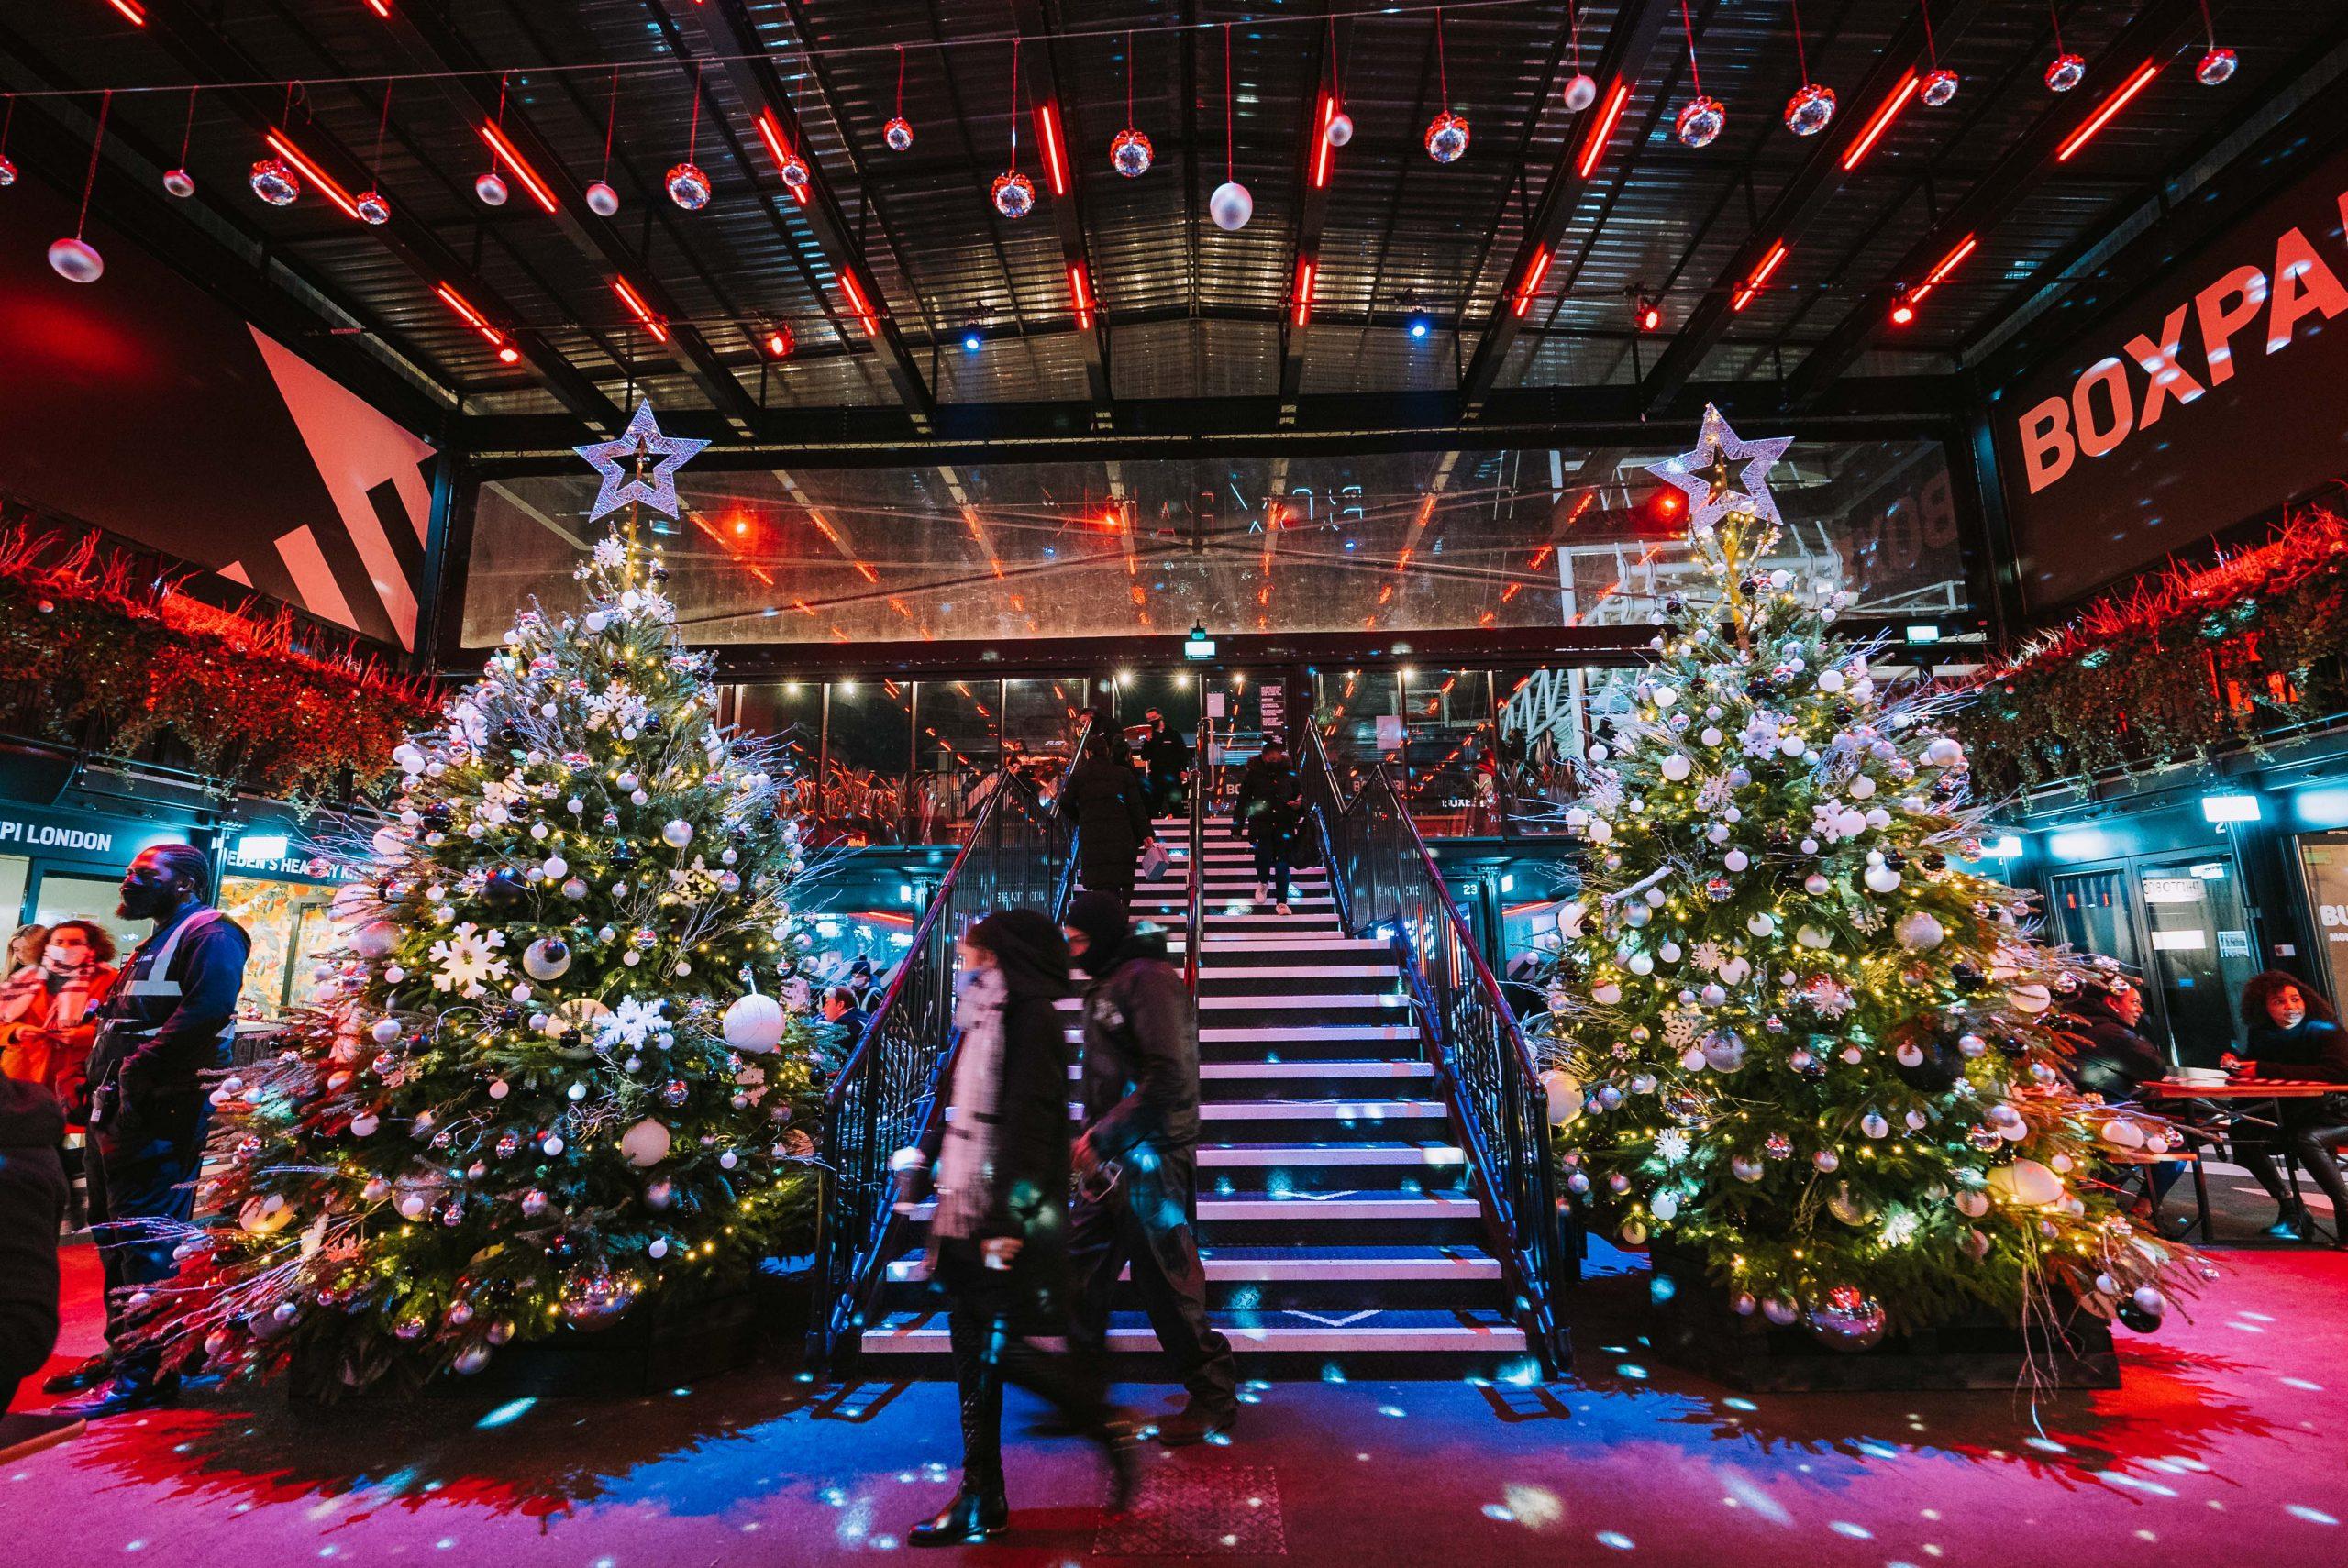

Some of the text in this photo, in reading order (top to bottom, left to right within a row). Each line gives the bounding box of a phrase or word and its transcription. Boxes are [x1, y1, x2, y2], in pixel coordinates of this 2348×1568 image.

[0, 821, 112, 851] PI LONDON
[1463, 884, 1478, 895] 23
